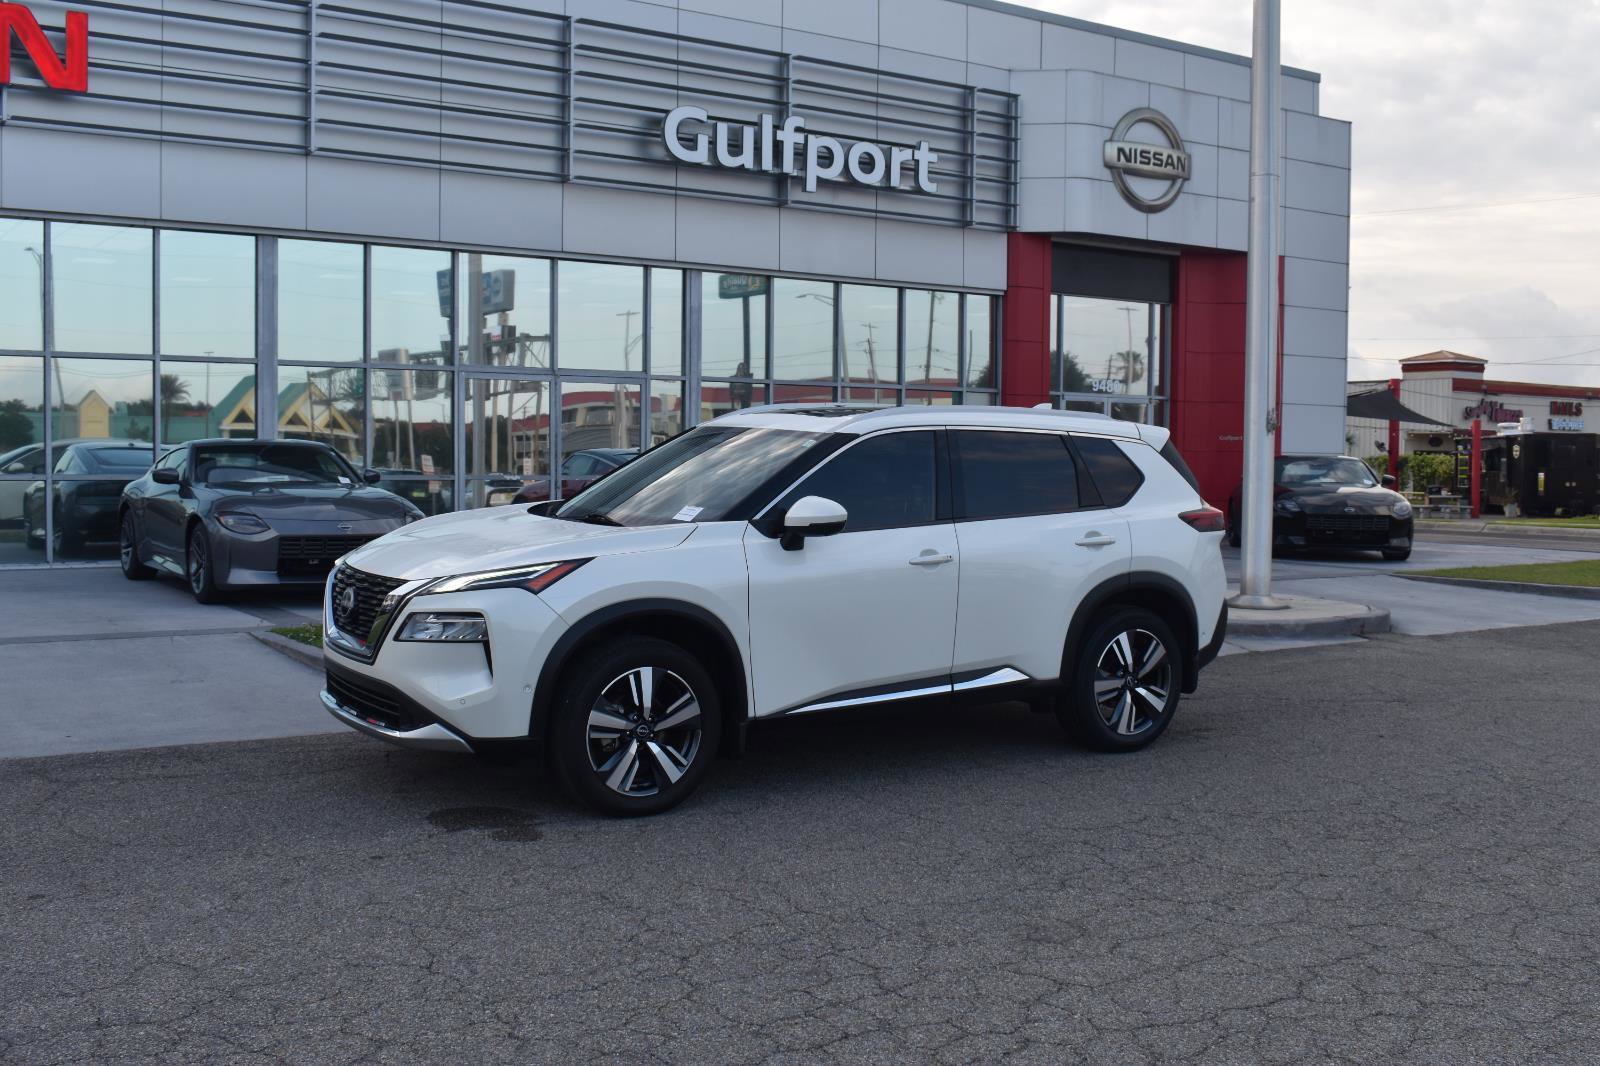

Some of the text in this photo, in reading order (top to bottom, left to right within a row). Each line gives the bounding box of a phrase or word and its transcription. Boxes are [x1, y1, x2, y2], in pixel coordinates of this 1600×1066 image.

[664, 106, 938, 193] Gulfport
[1117, 146, 1187, 173] NISSAN
[1092, 378, 1121, 393] 9480
